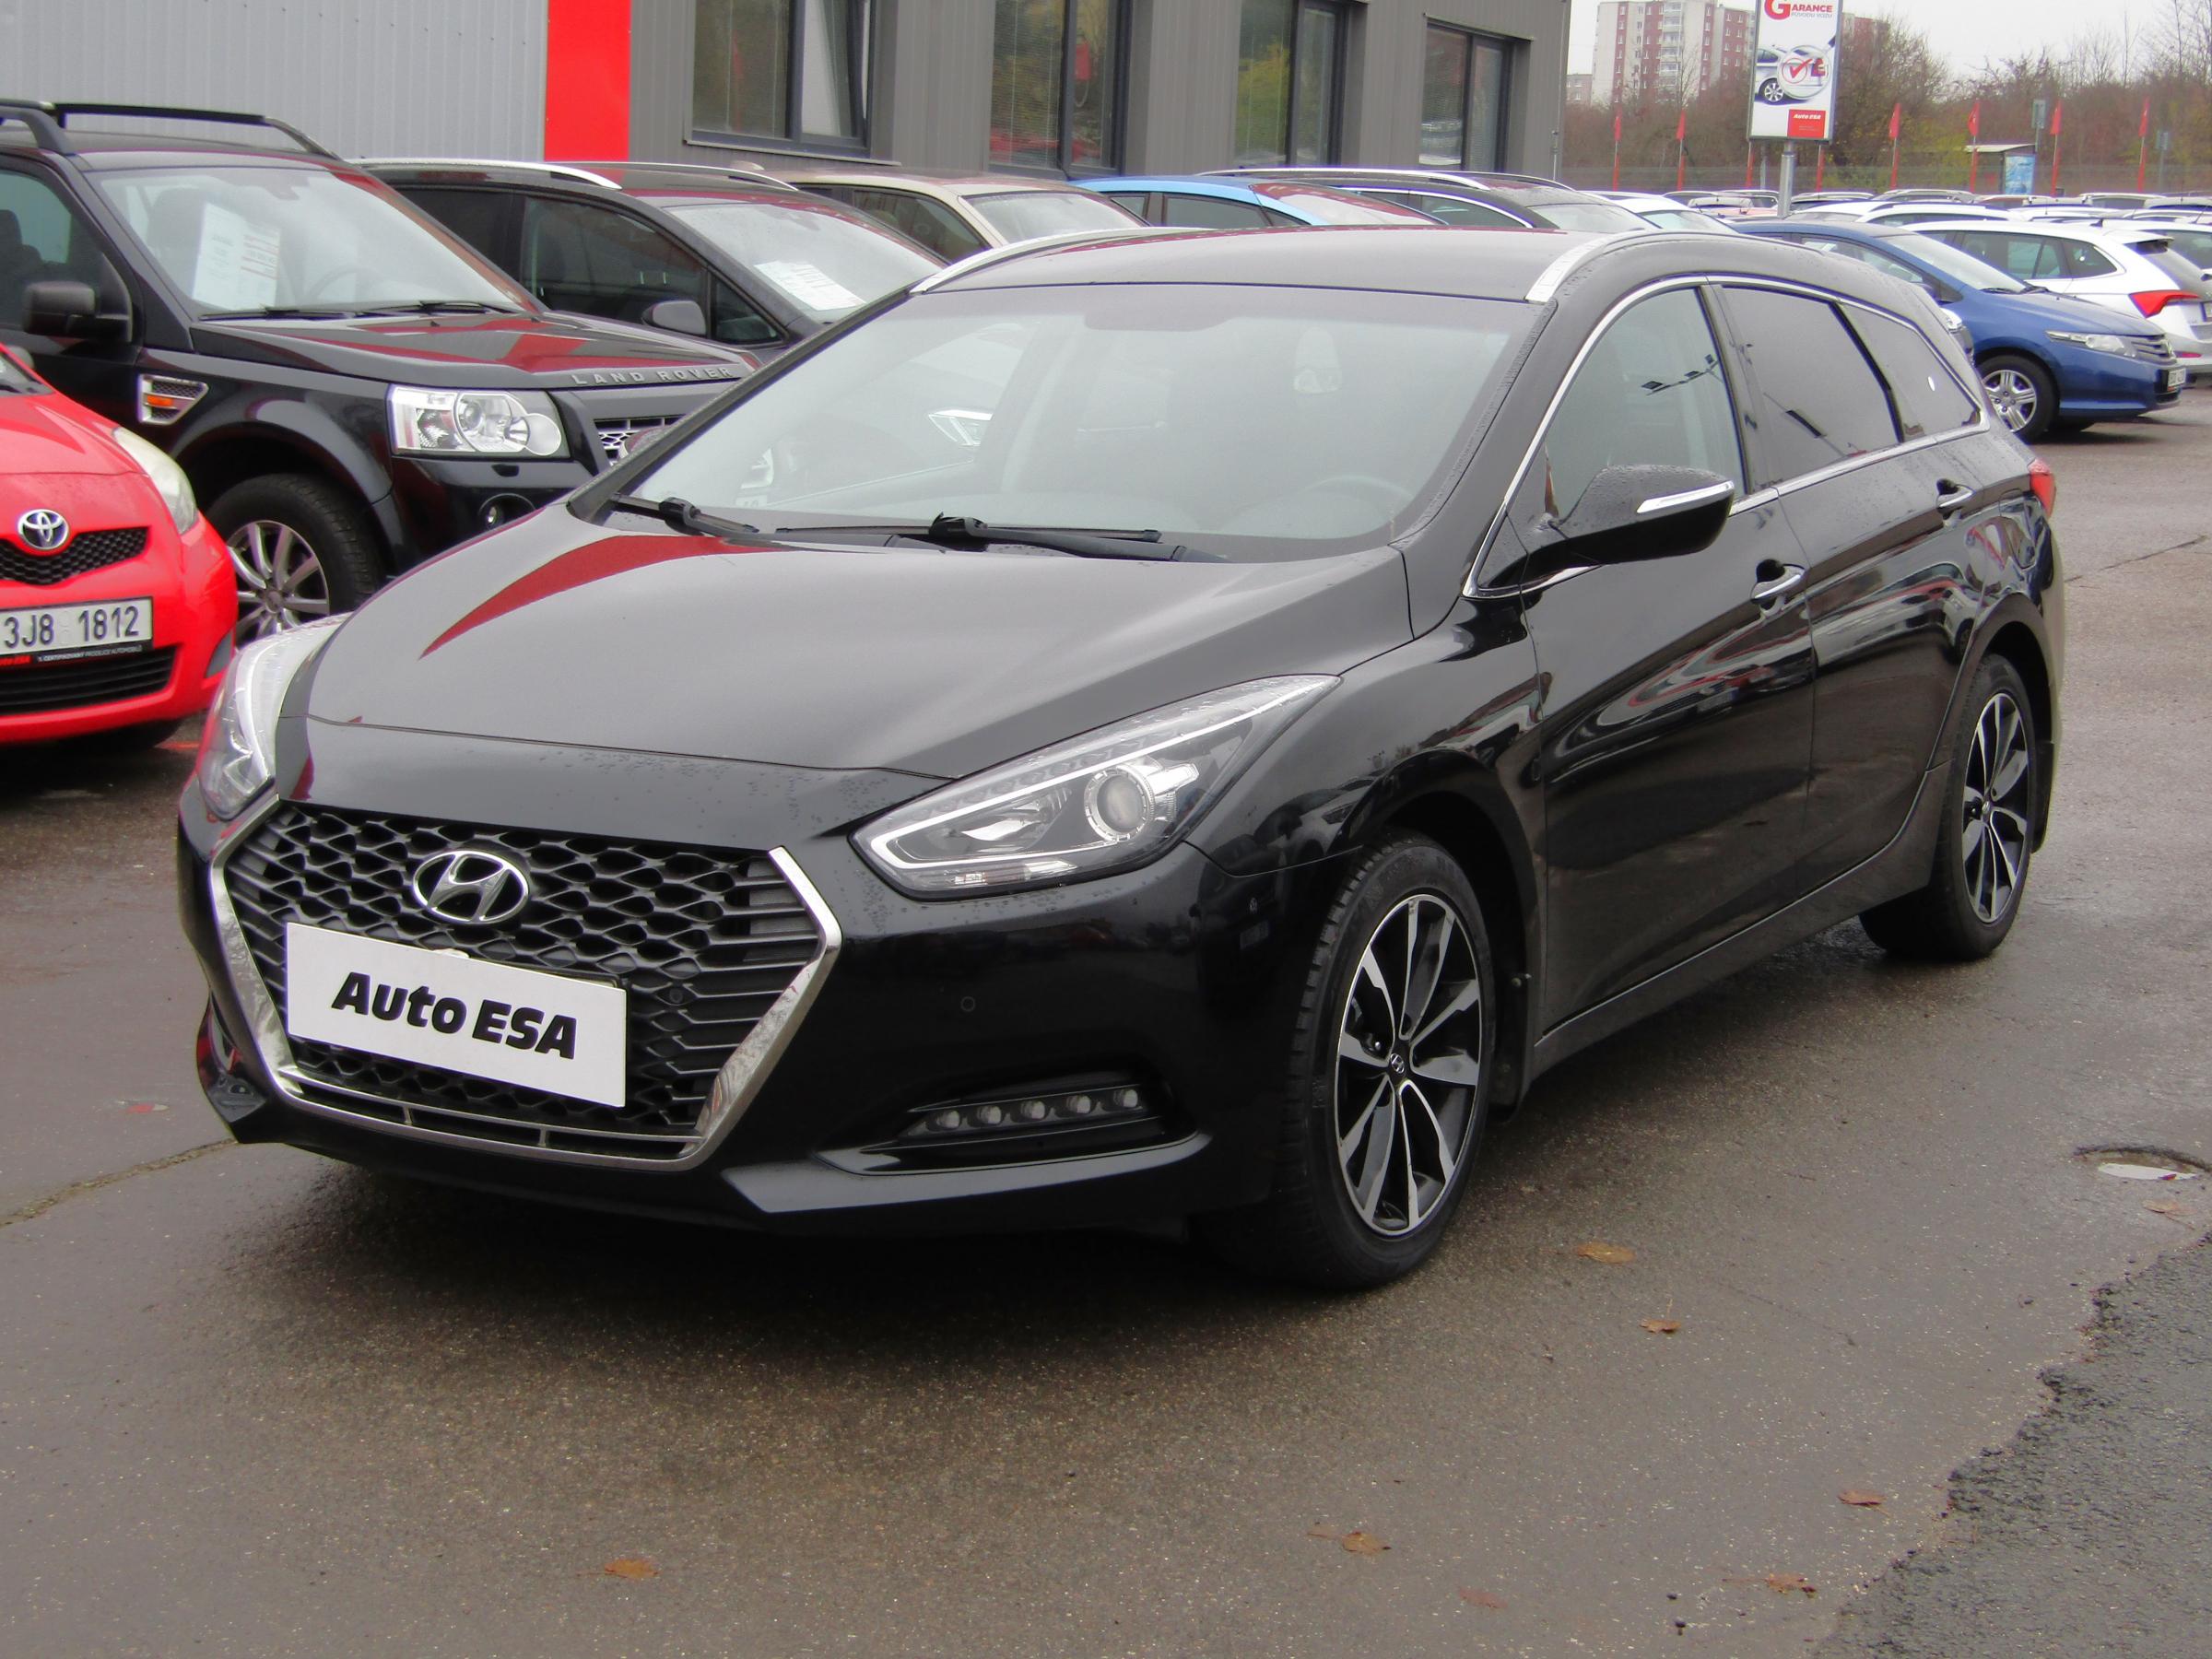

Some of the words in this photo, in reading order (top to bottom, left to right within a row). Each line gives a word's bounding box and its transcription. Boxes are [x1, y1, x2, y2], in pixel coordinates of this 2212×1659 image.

[1764, 0, 1833, 19] GARANCE
[571, 371, 645, 385] LAND
[656, 368, 733, 382] ROVER
[4, 613, 54, 648] 3J8
[78, 605, 139, 642] 1812
[331, 971, 467, 1034] Auto
[472, 999, 577, 1059] ESA
